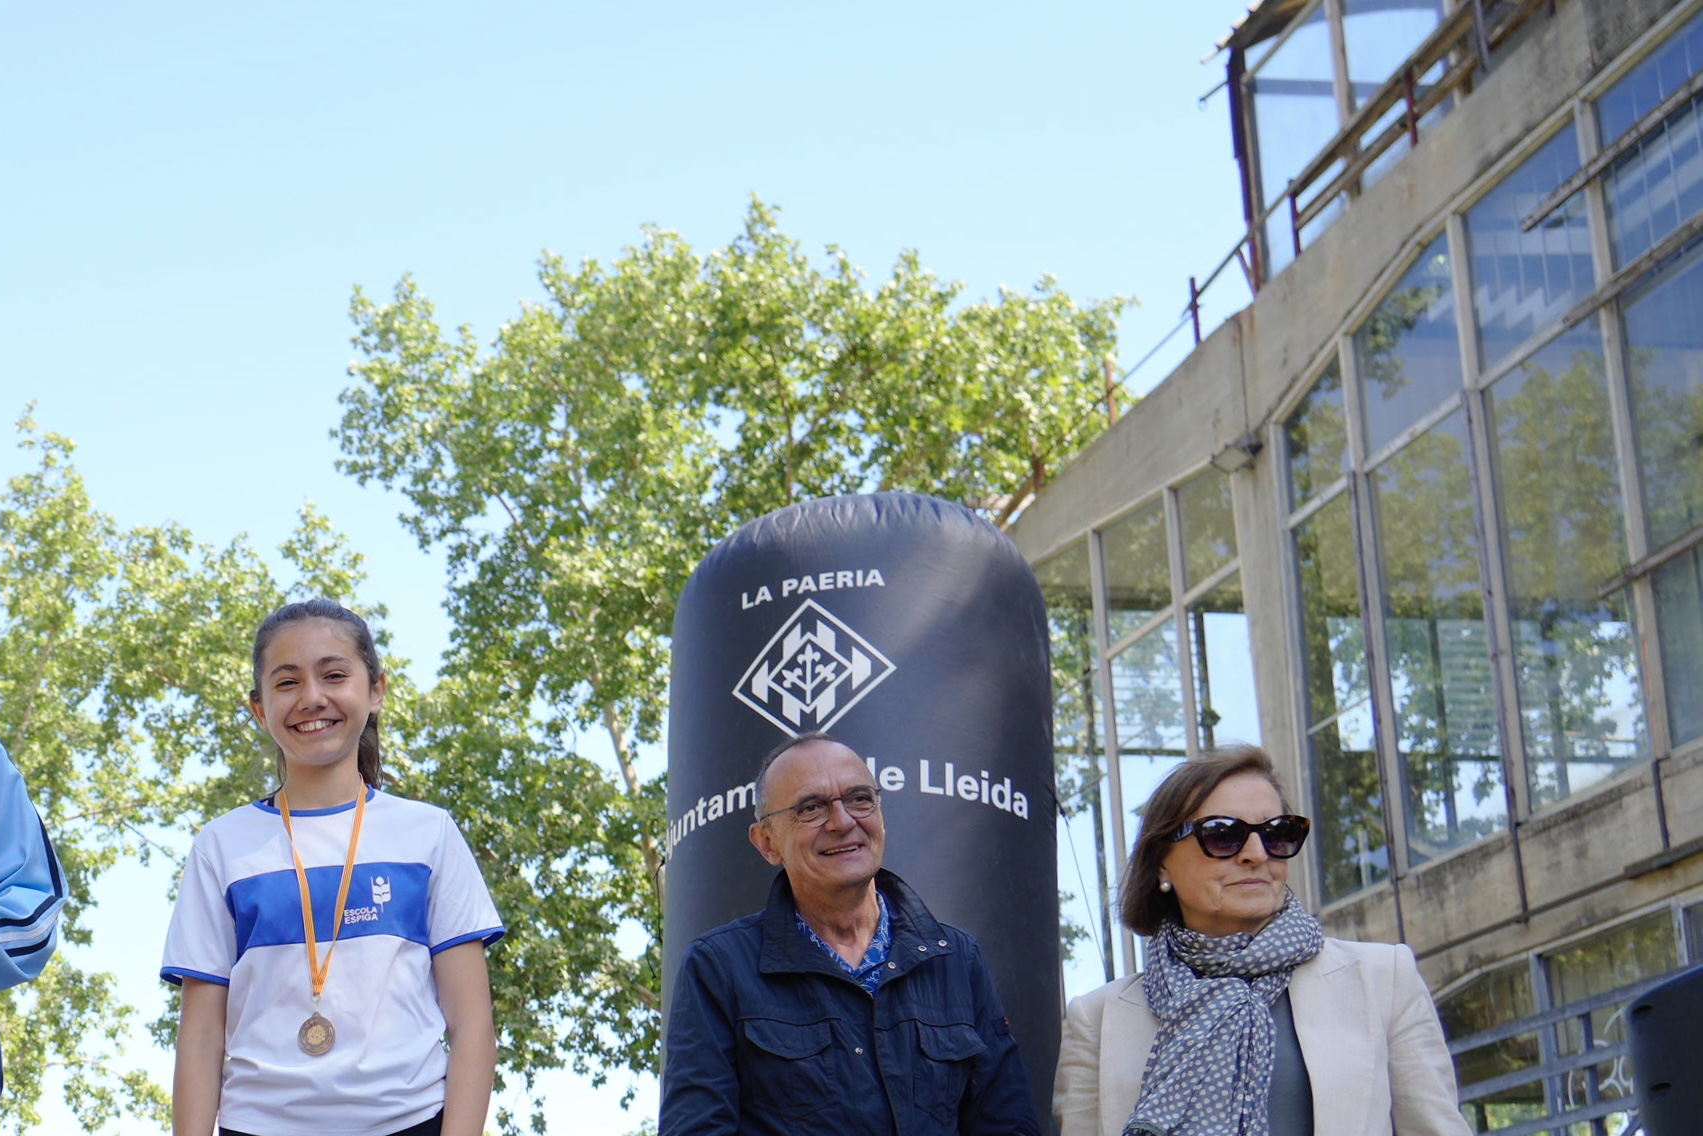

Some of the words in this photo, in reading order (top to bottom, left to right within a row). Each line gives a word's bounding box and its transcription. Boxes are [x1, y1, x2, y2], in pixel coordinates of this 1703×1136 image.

[741, 585, 773, 611] LA
[782, 568, 885, 599] PAERIA
[666, 781, 757, 862] juntam
[919, 758, 1030, 821] Lleida
[343, 906, 378, 917] ESCOLA
[344, 913, 379, 925] ESPIGA
